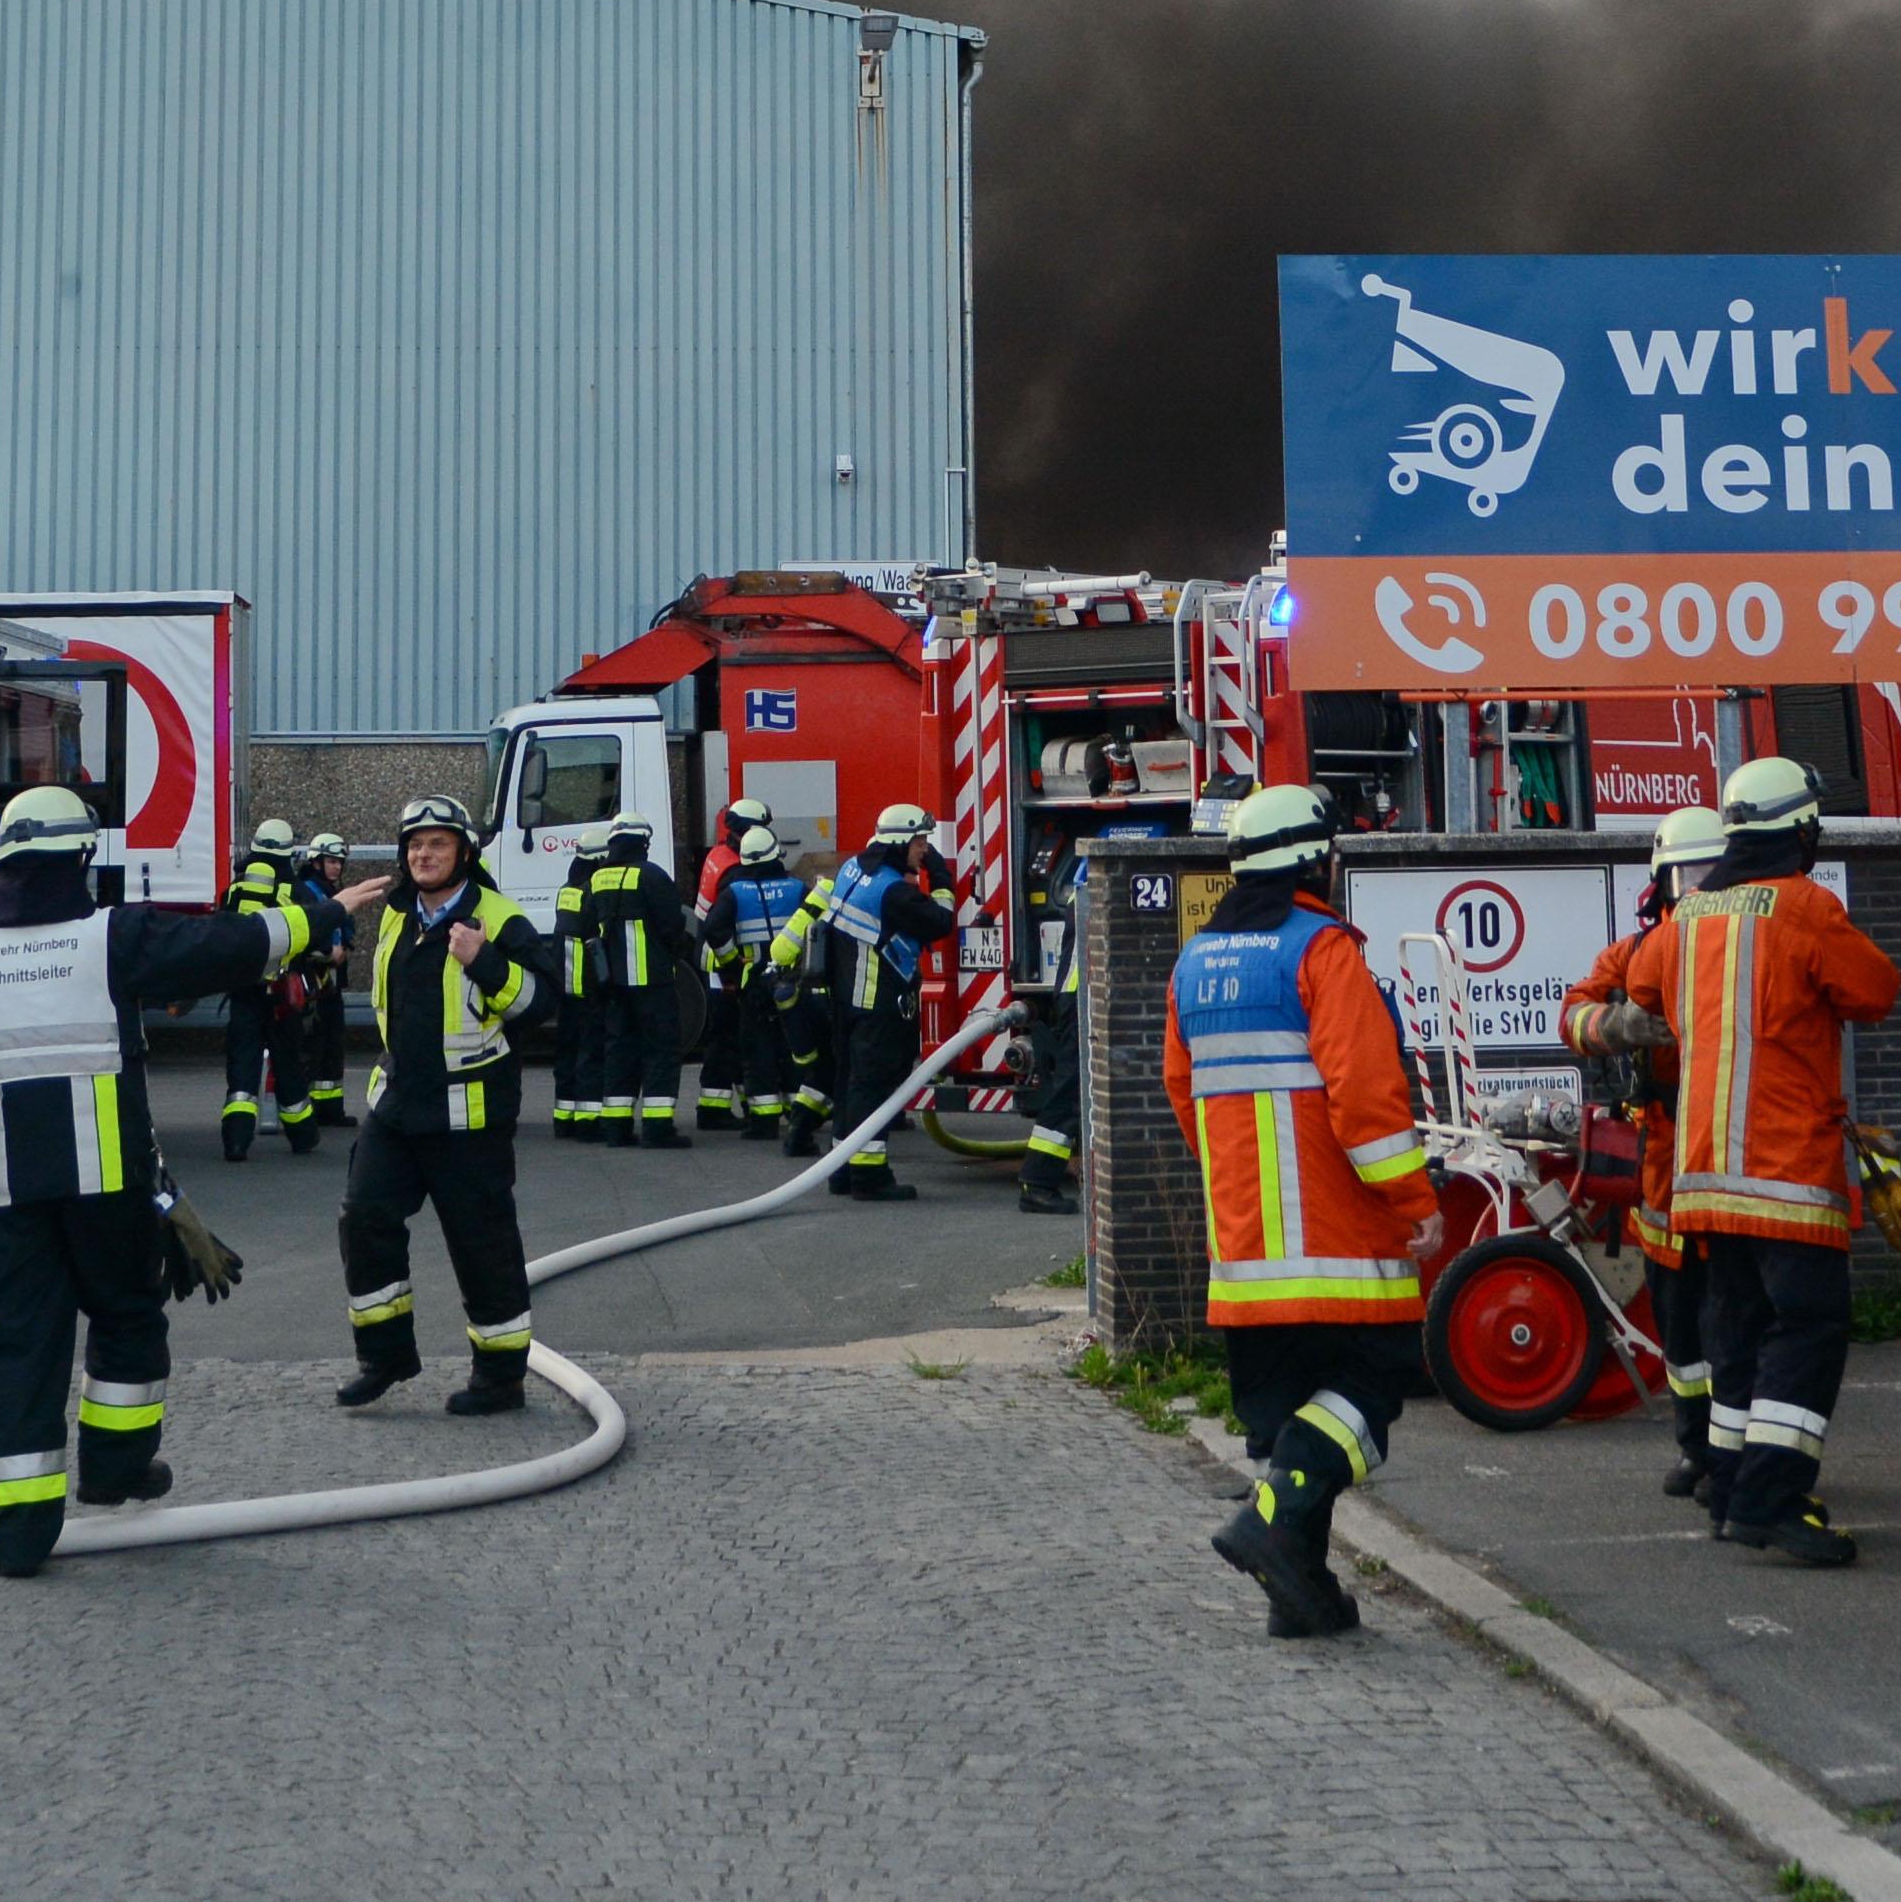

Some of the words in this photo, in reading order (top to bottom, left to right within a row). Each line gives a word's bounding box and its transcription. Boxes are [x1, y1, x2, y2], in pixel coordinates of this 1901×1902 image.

[1528, 581, 1784, 658] 0800
[1595, 765, 1701, 805] NÜRNBERG
[1136, 877, 1168, 909] 24
[1186, 900, 1205, 916] ist
[1458, 901, 1501, 949] 10
[23, 937, 79, 954] Nürnberg
[981, 929, 990, 947] N
[1228, 933, 1280, 951] Nürnberg
[961, 949, 976, 966] FW
[1197, 978, 1218, 1005] LF
[1222, 976, 1240, 1003] 10
[1500, 1009, 1546, 1035] StVO
[1477, 1075, 1575, 1092] rivatgrundstück!
